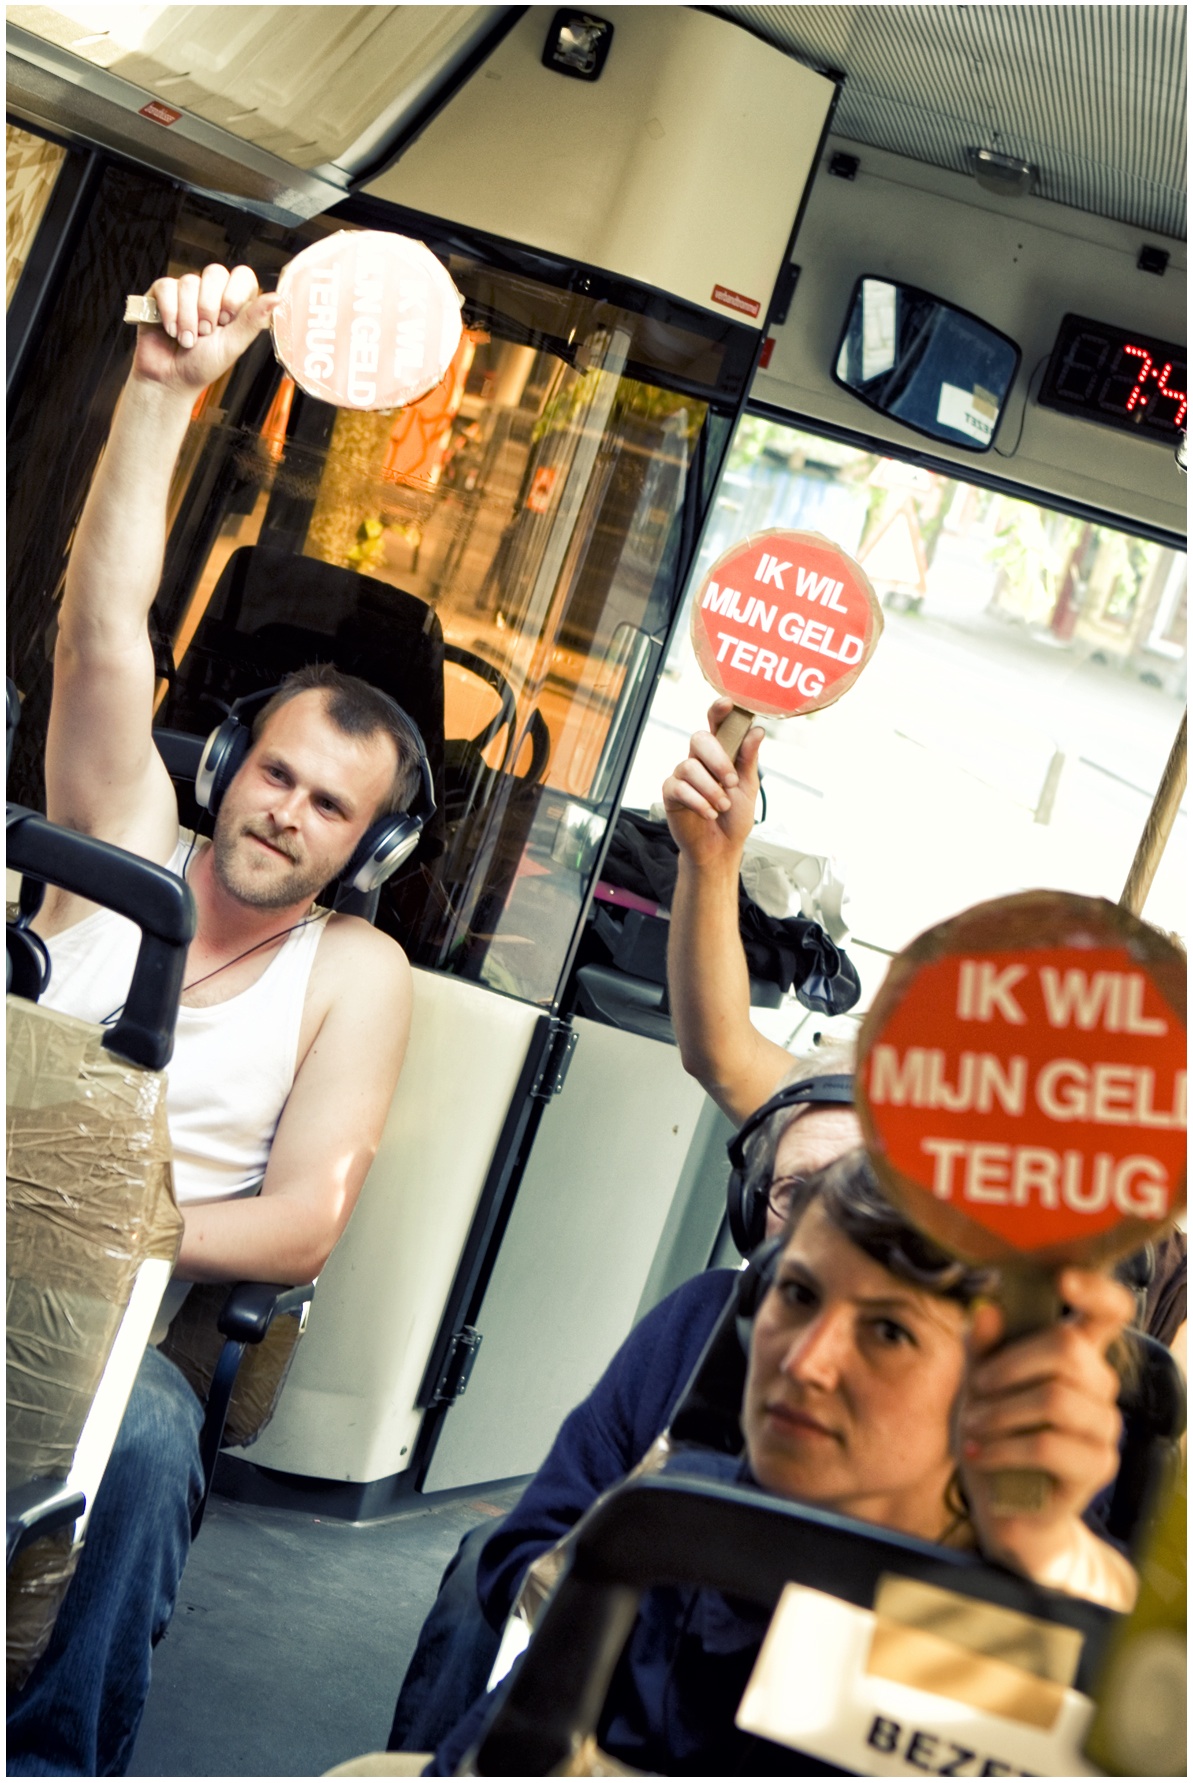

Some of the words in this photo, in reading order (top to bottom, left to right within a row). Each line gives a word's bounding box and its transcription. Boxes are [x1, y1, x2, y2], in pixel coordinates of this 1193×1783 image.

[304, 262, 341, 379] TERUG
[347, 316, 381, 406] GELD
[701, 581, 778, 633] MIJN
[777, 612, 864, 665] GELD
[754, 553, 793, 590] IK
[795, 566, 848, 614] WIL
[715, 632, 826, 698] TERUG
[956, 959, 1028, 1026] IK
[1039, 964, 1168, 1037] WIL
[870, 1043, 1028, 1116] MIJN
[1036, 1057, 1187, 1130] GEL
[920, 1136, 1170, 1220] TERUG
[866, 1714, 1041, 1777] BEZ
